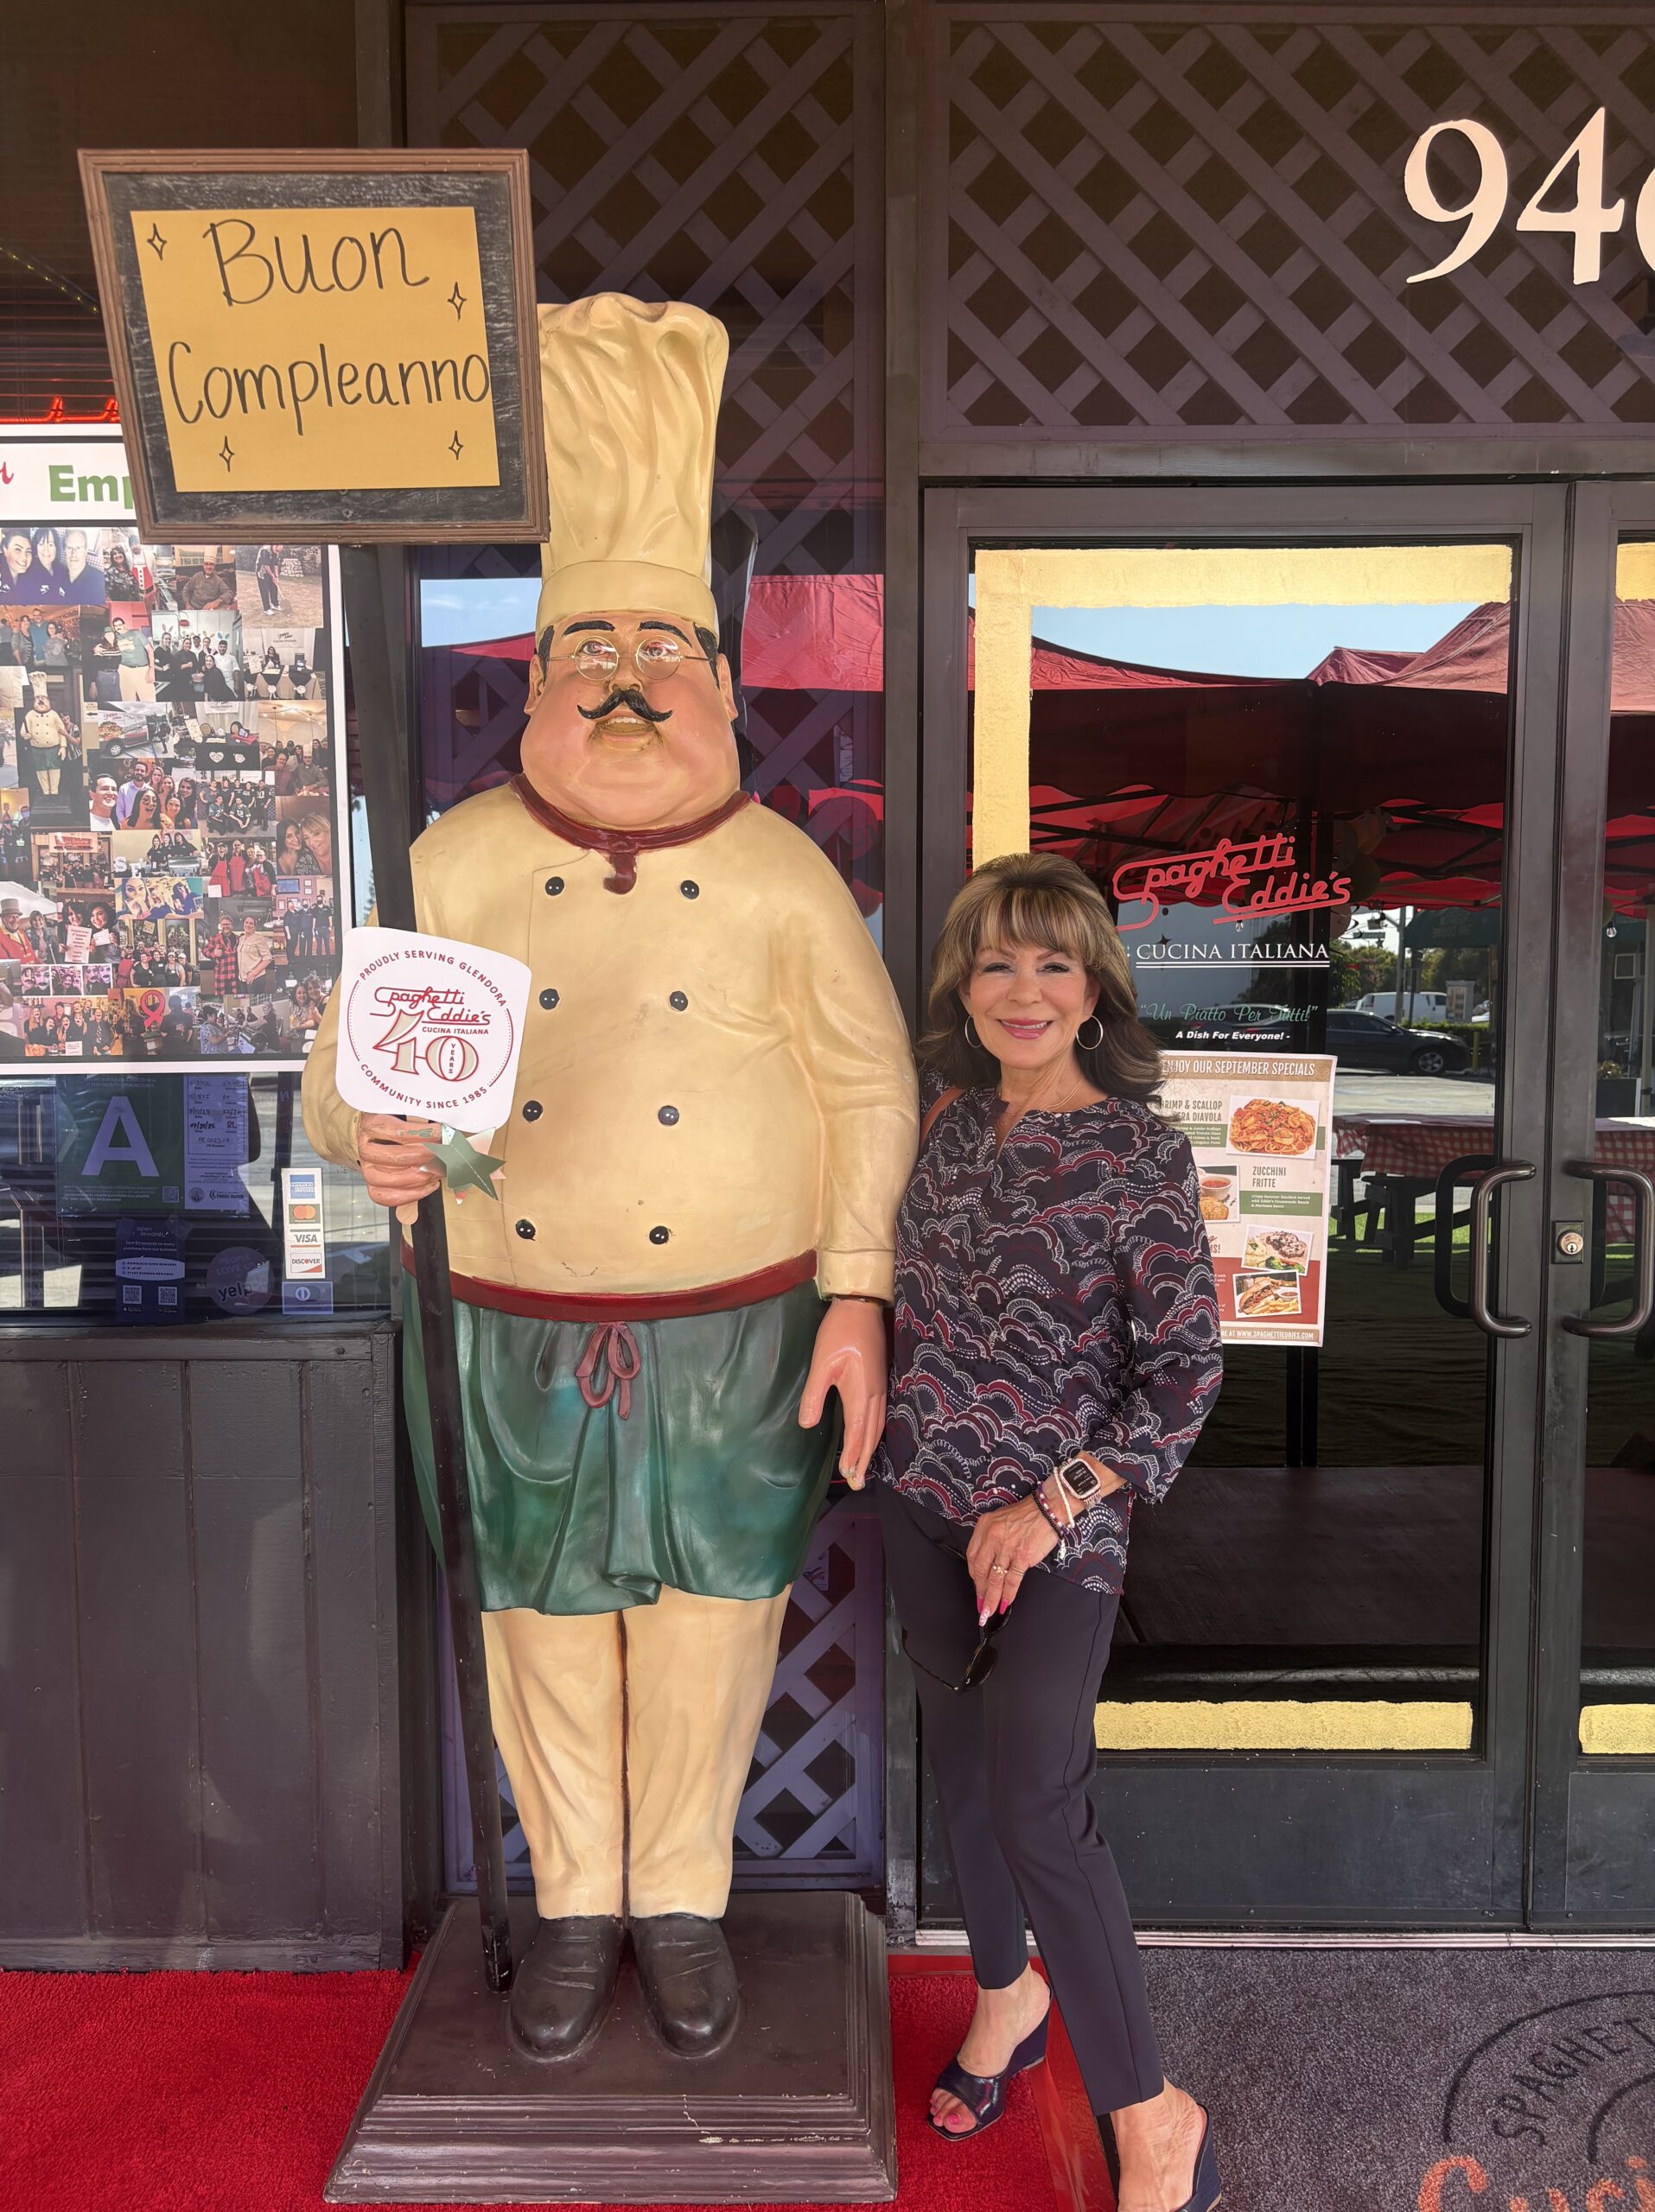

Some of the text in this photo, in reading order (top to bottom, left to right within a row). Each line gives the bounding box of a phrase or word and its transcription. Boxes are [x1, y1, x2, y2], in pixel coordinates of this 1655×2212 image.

[1404, 106, 1655, 285] 94
[202, 219, 430, 306] Buon
[169, 341, 490, 435] Compleanno
[1113, 833, 1295, 931] Spaghetti
[1213, 871, 1351, 925] Eddie's
[1136, 943, 1329, 960] CUCINA ITALIANA
[360, 950, 506, 1007] PROUDLY SERVING GLENDORA
[370, 986, 465, 1017] Spaghetti
[1180, 1003, 1226, 1021] Piatto
[1234, 1004, 1262, 1021] Per
[422, 1003, 491, 1026] Eddie's
[372, 1009, 479, 1082] 40
[1187, 1031, 1210, 1039] Dish
[1212, 1031, 1230, 1039] For
[1232, 1032, 1284, 1041] Everyone!
[1162, 1059, 1315, 1076] ENJOY OUR SEPTEMBER SPECIALS
[360, 1064, 487, 1109] COMMUNITY SINCE 1985
[1161, 1100, 1223, 1110] HRIMP & SCALLOP
[1192, 1112, 1221, 1122] DIAVOLA
[81, 1096, 159, 1177] A
[1252, 1166, 1287, 1176] ZUCCHINI
[1252, 1178, 1276, 1188] FRITTE
[294, 1234, 317, 1243] VISA
[218, 1282, 252, 1301] yelp
